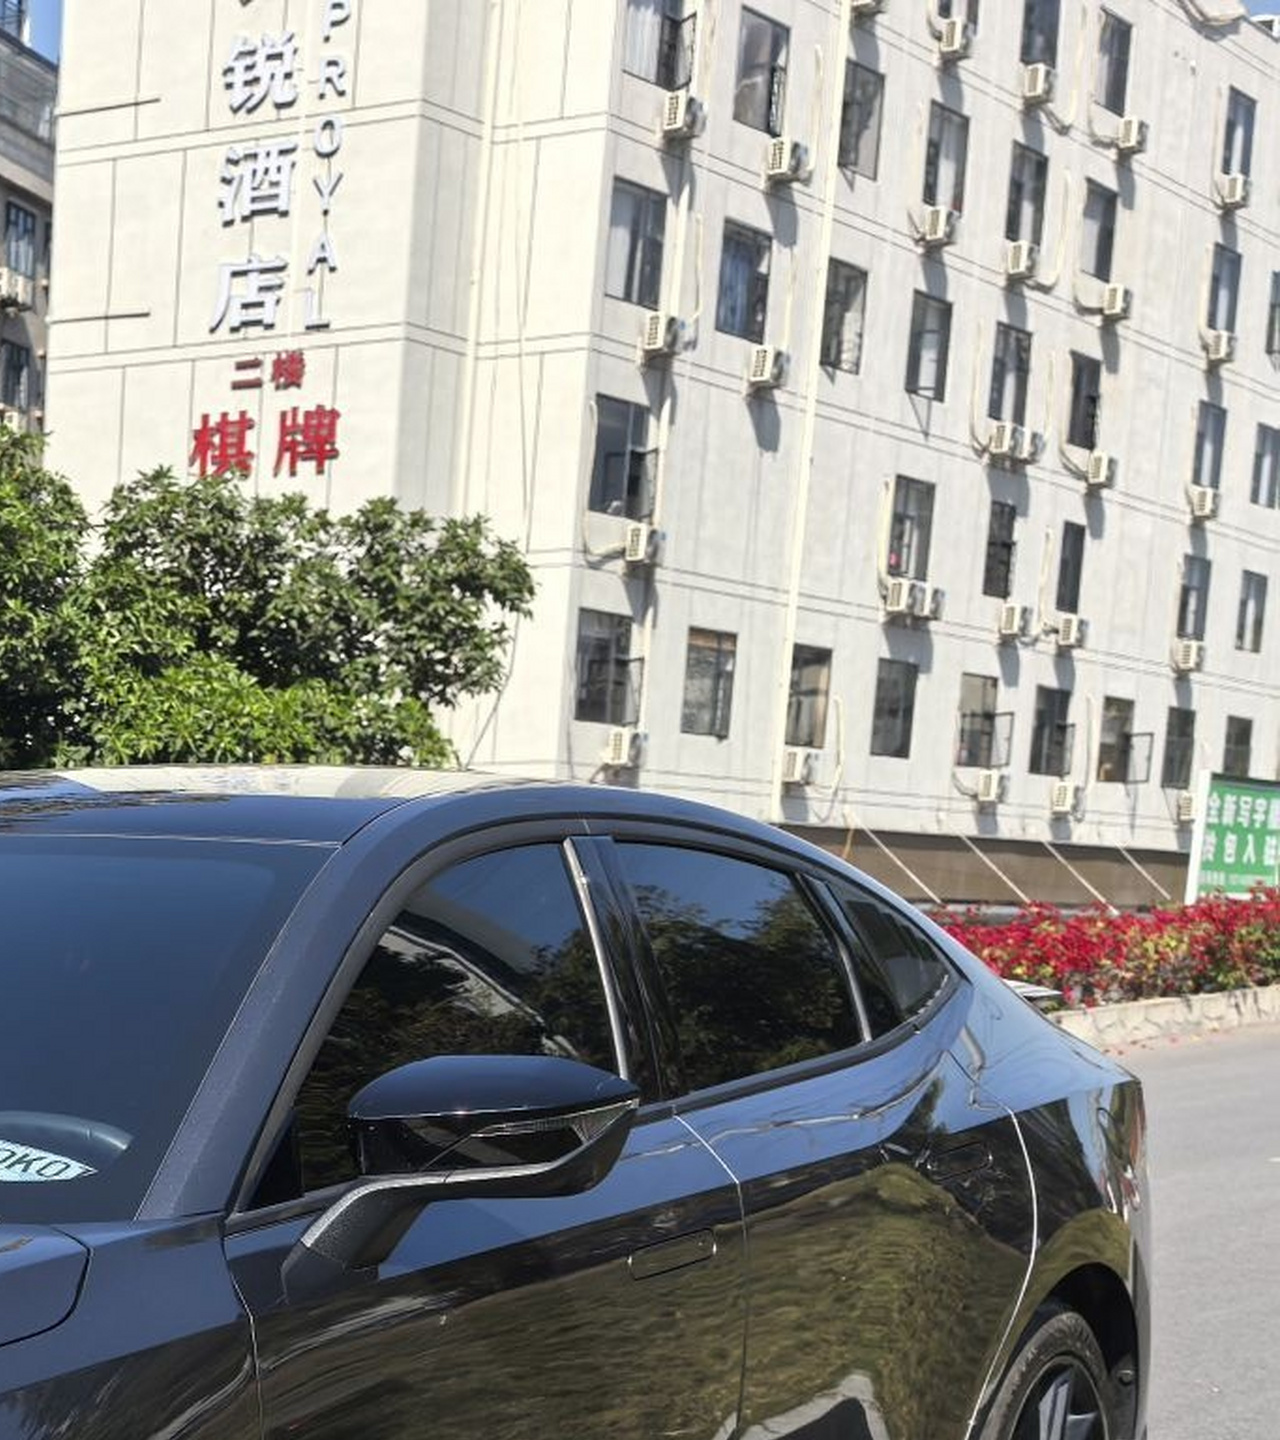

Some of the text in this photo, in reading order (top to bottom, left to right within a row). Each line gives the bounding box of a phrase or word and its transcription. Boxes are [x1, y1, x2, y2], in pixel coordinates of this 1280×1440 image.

[209, 0, 299, 334] 锐酒店
[231, 349, 306, 391] 二楼
[188, 404, 341, 480] 棋牌
